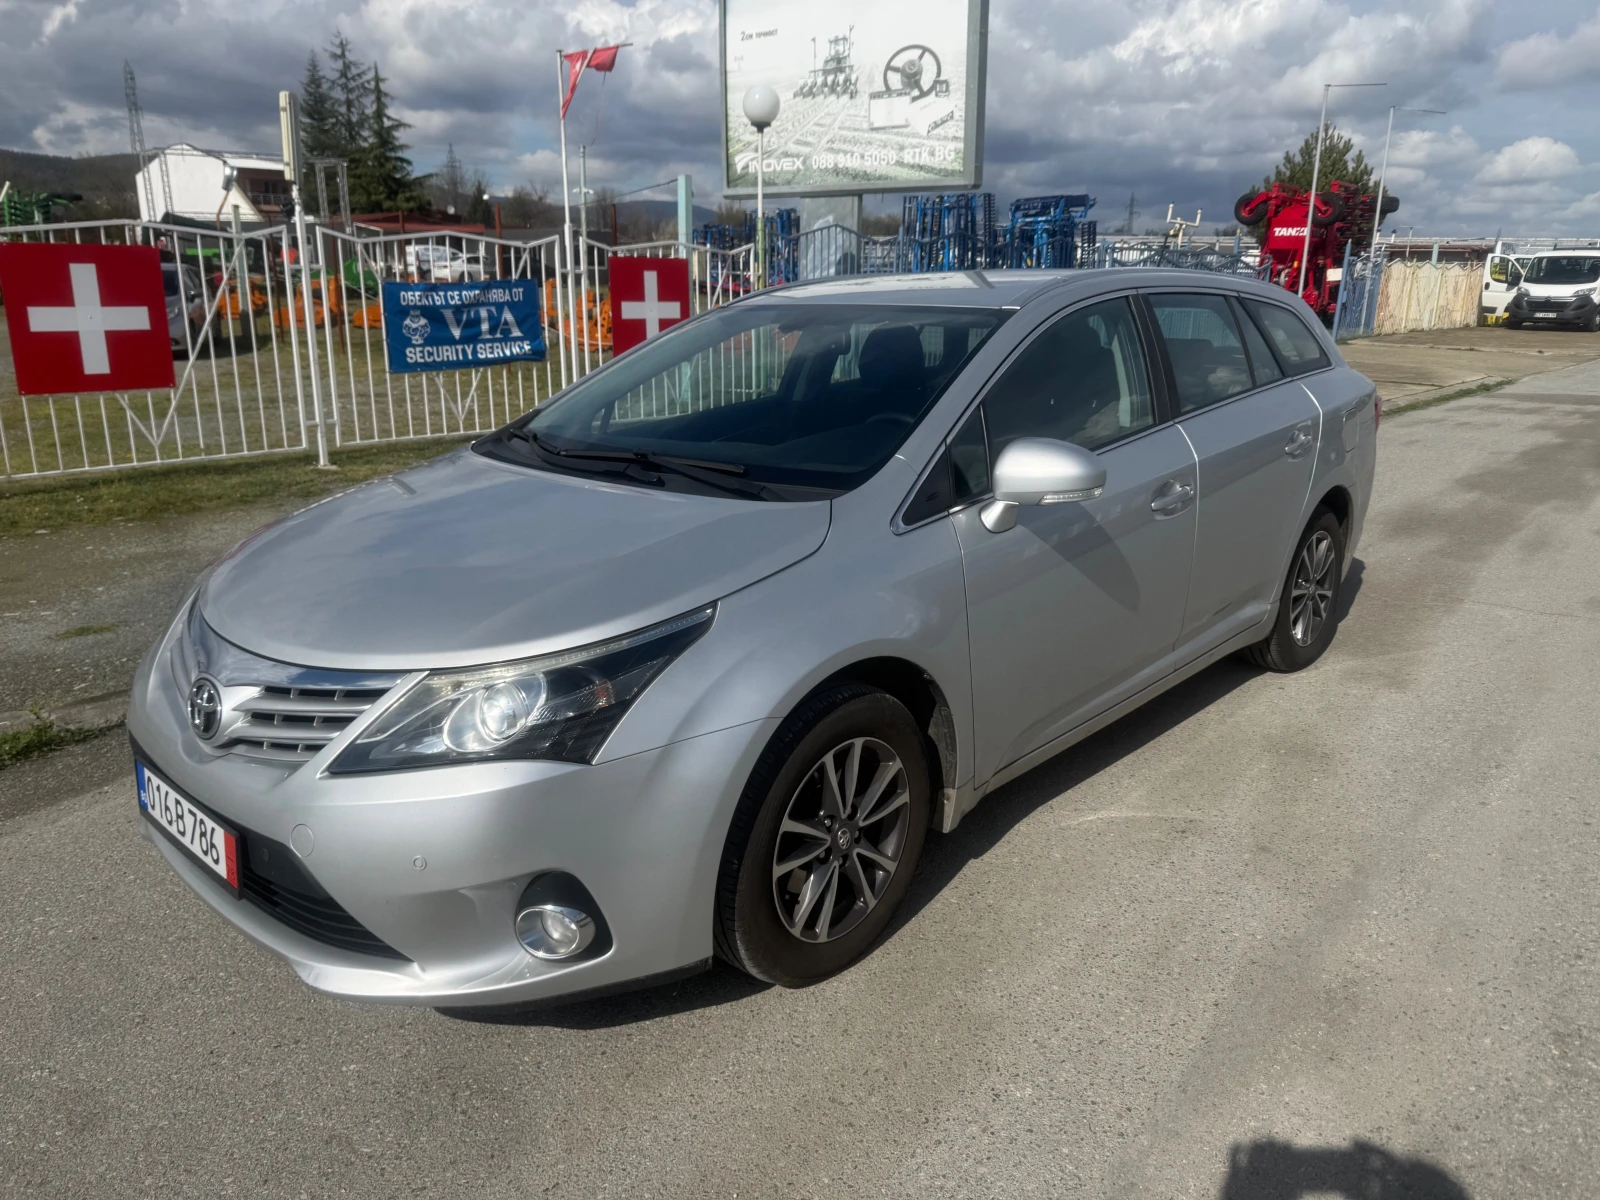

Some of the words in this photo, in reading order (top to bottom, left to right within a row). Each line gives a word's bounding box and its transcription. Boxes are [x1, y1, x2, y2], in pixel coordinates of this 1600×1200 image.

[748, 156, 804, 173] INOVEX
[812, 156, 834, 170] 088
[837, 153, 860, 168] 910
[864, 151, 896, 165] 5050
[903, 147, 955, 163] RTK.BG
[400, 290, 446, 306] ОБЕКТЪТ
[447, 291, 462, 305] СЕ
[462, 289, 511, 305] ОХРАНЯВА
[512, 288, 524, 301] ОТ
[440, 305, 524, 341] VTA
[405, 343, 474, 363] SECURITY
[476, 340, 533, 359] SERVICE
